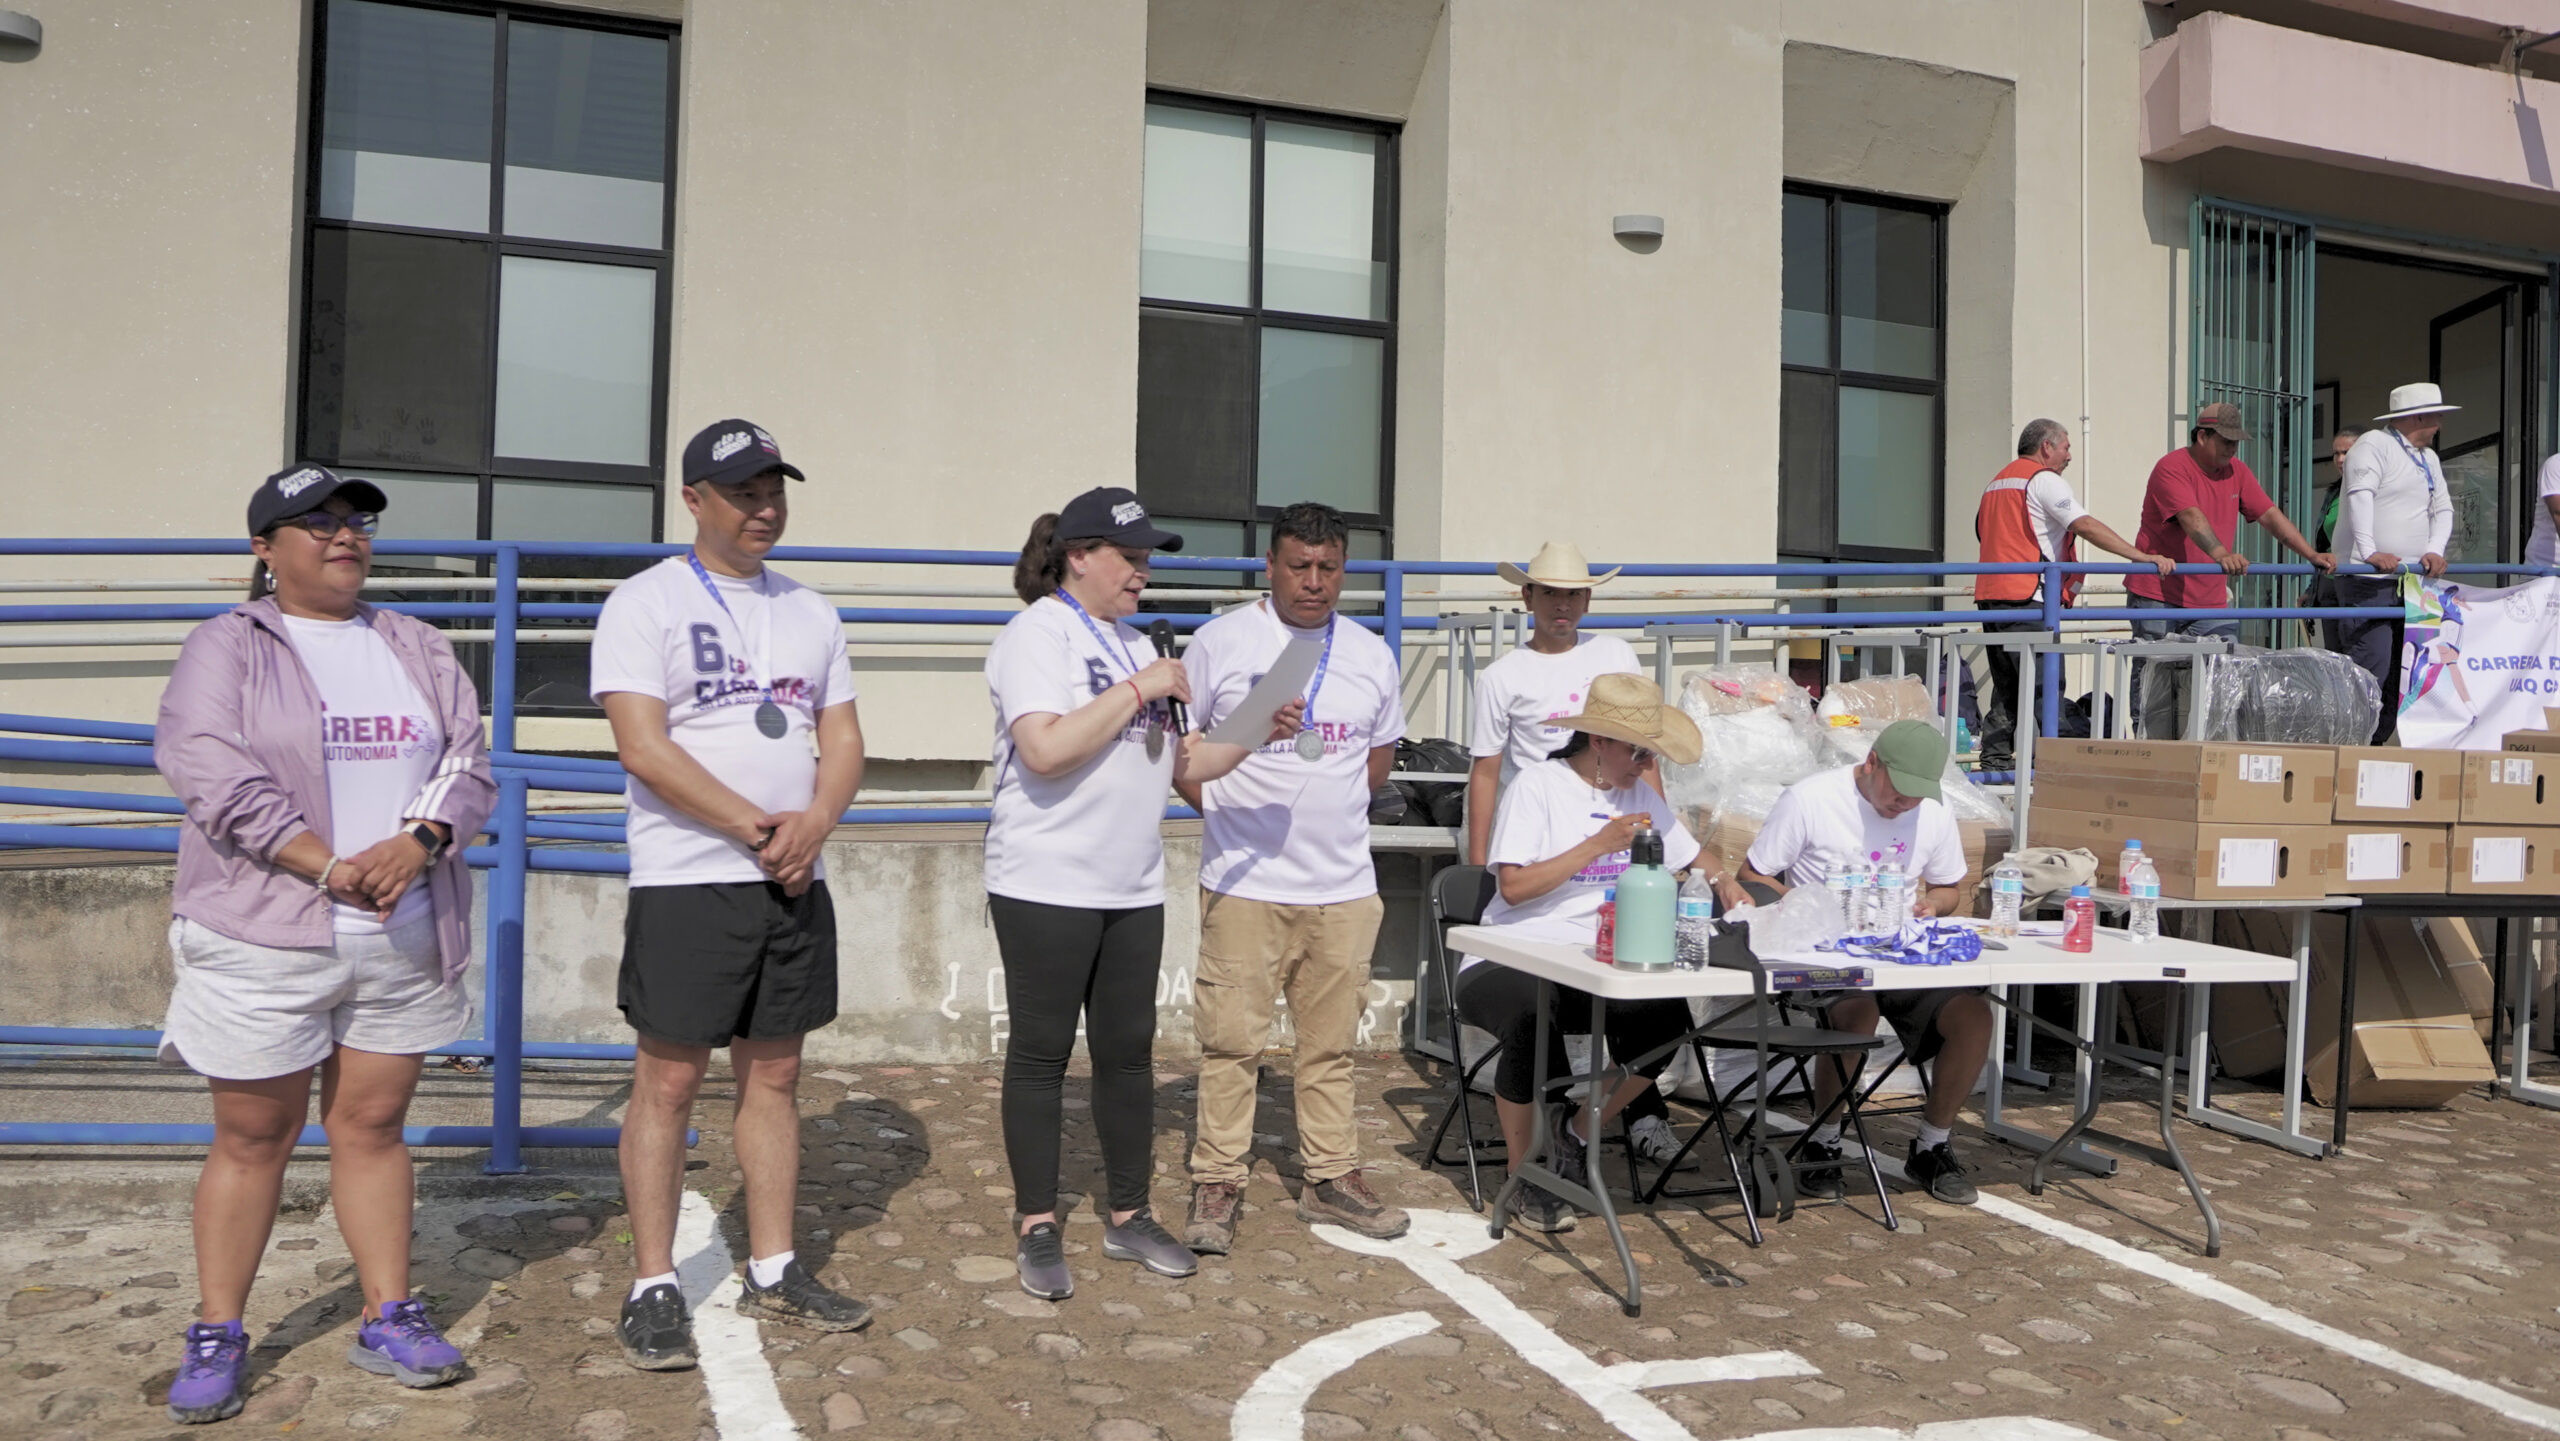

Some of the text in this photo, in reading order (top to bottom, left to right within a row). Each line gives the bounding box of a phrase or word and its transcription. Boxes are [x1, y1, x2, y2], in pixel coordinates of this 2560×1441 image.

[2467, 655, 2543, 671] CARRERA
[2509, 678, 2537, 695] UAQ
[322, 715, 419, 742] RERA
[324, 744, 398, 761] UTONOMIA
